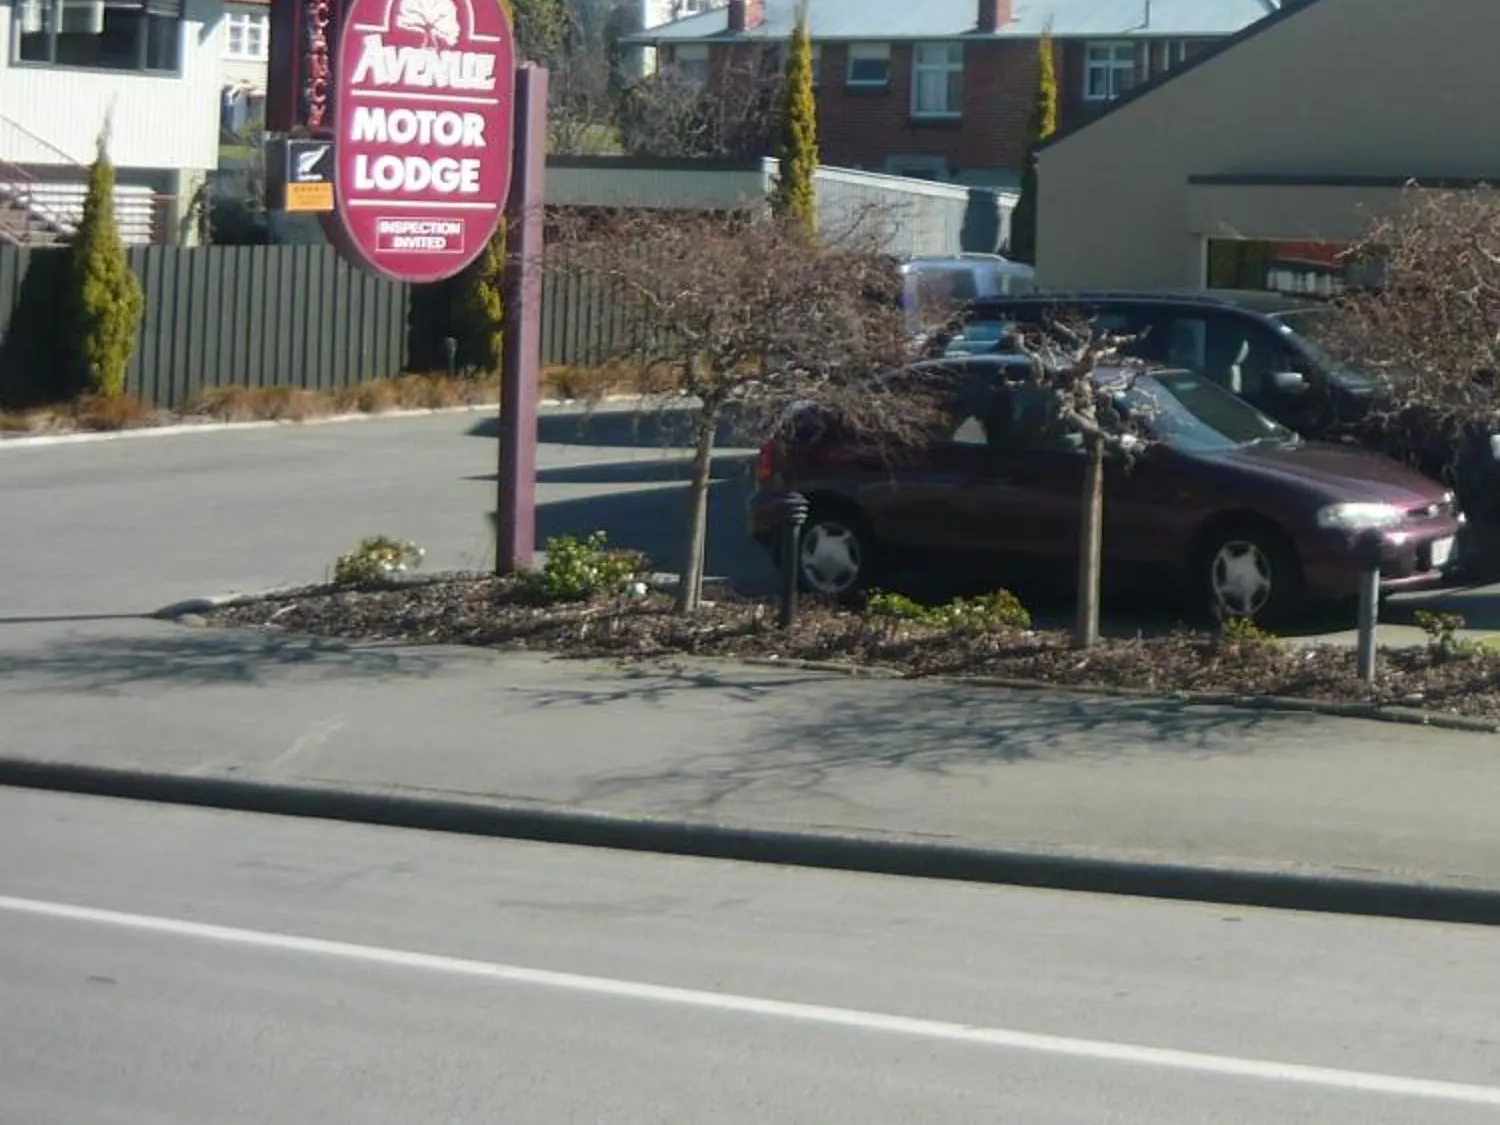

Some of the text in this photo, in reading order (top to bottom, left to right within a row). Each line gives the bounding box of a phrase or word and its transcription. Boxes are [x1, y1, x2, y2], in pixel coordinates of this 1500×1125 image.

[350, 34, 496, 92] AVENUE
[351, 107, 486, 148] MOTOR
[354, 155, 481, 193] LODGE
[380, 220, 461, 235] INSPECTION
[393, 236, 447, 249] INVITED
